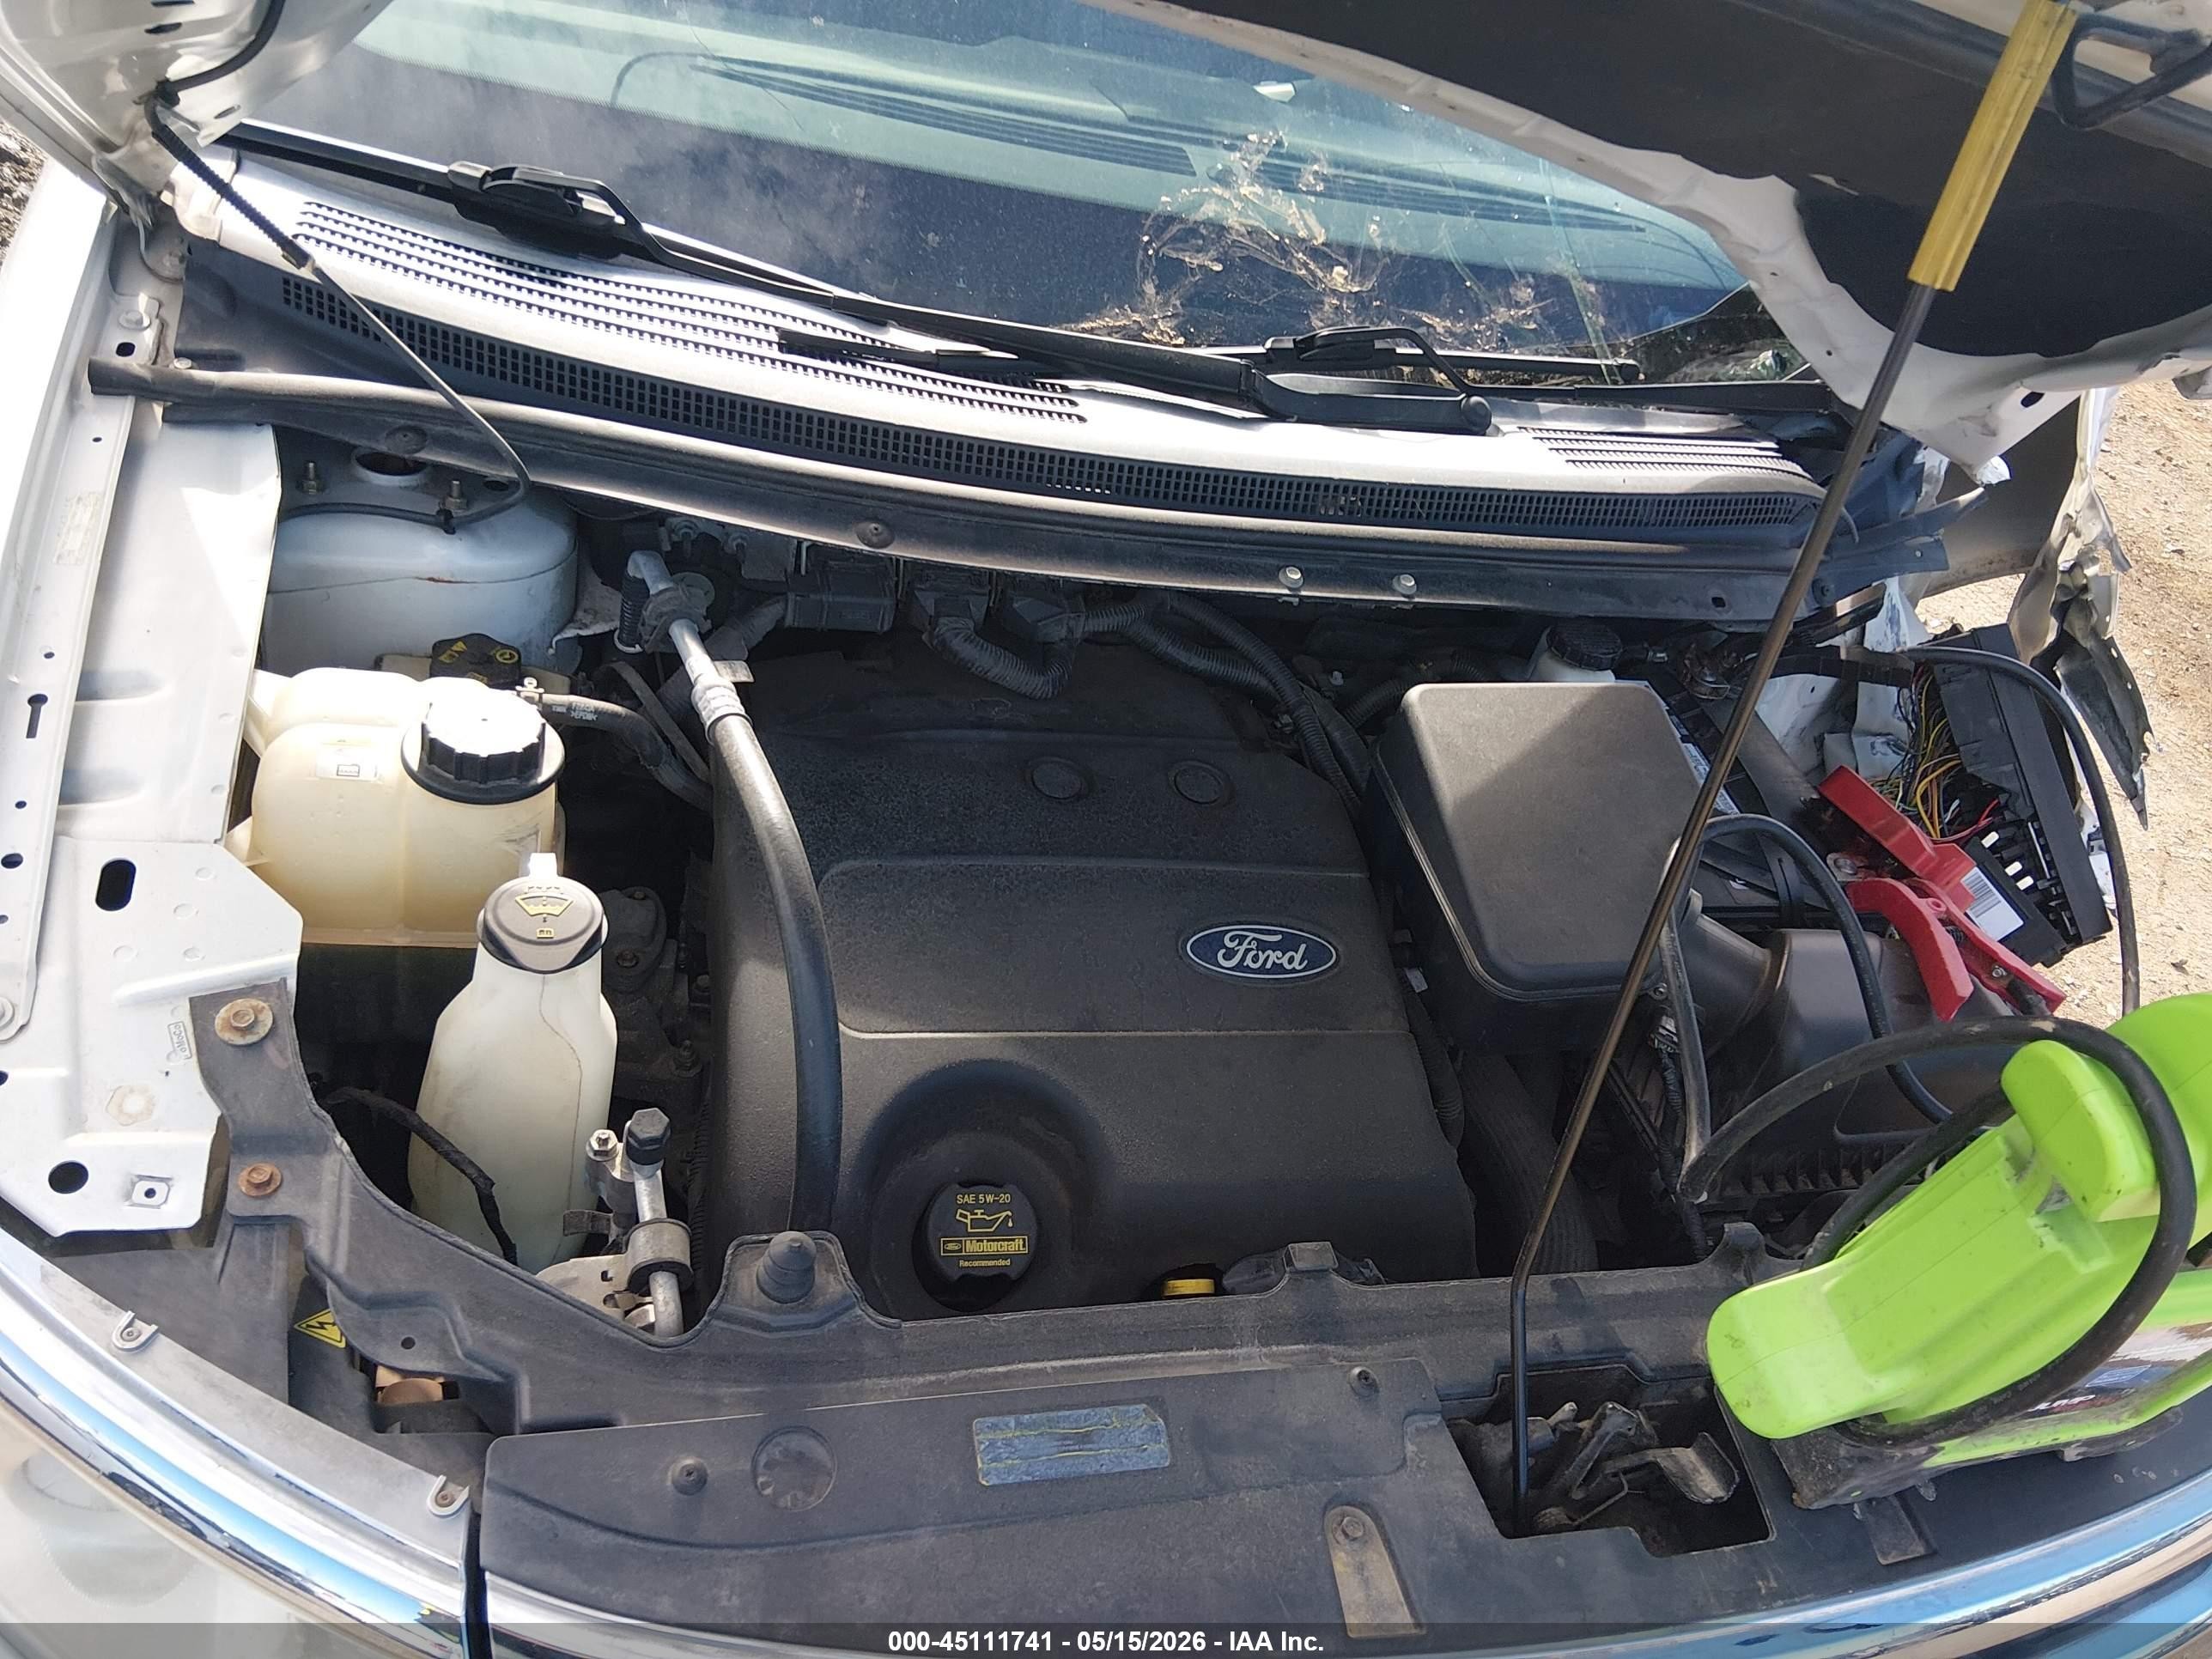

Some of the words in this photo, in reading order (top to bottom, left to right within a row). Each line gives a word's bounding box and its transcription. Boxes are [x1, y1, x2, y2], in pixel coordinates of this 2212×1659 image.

[1217, 930, 1309, 970] Ford
[957, 1194, 976, 1204] SAE
[979, 1194, 1012, 1204] 5W-20
[959, 1258, 1011, 1268] Recommended
